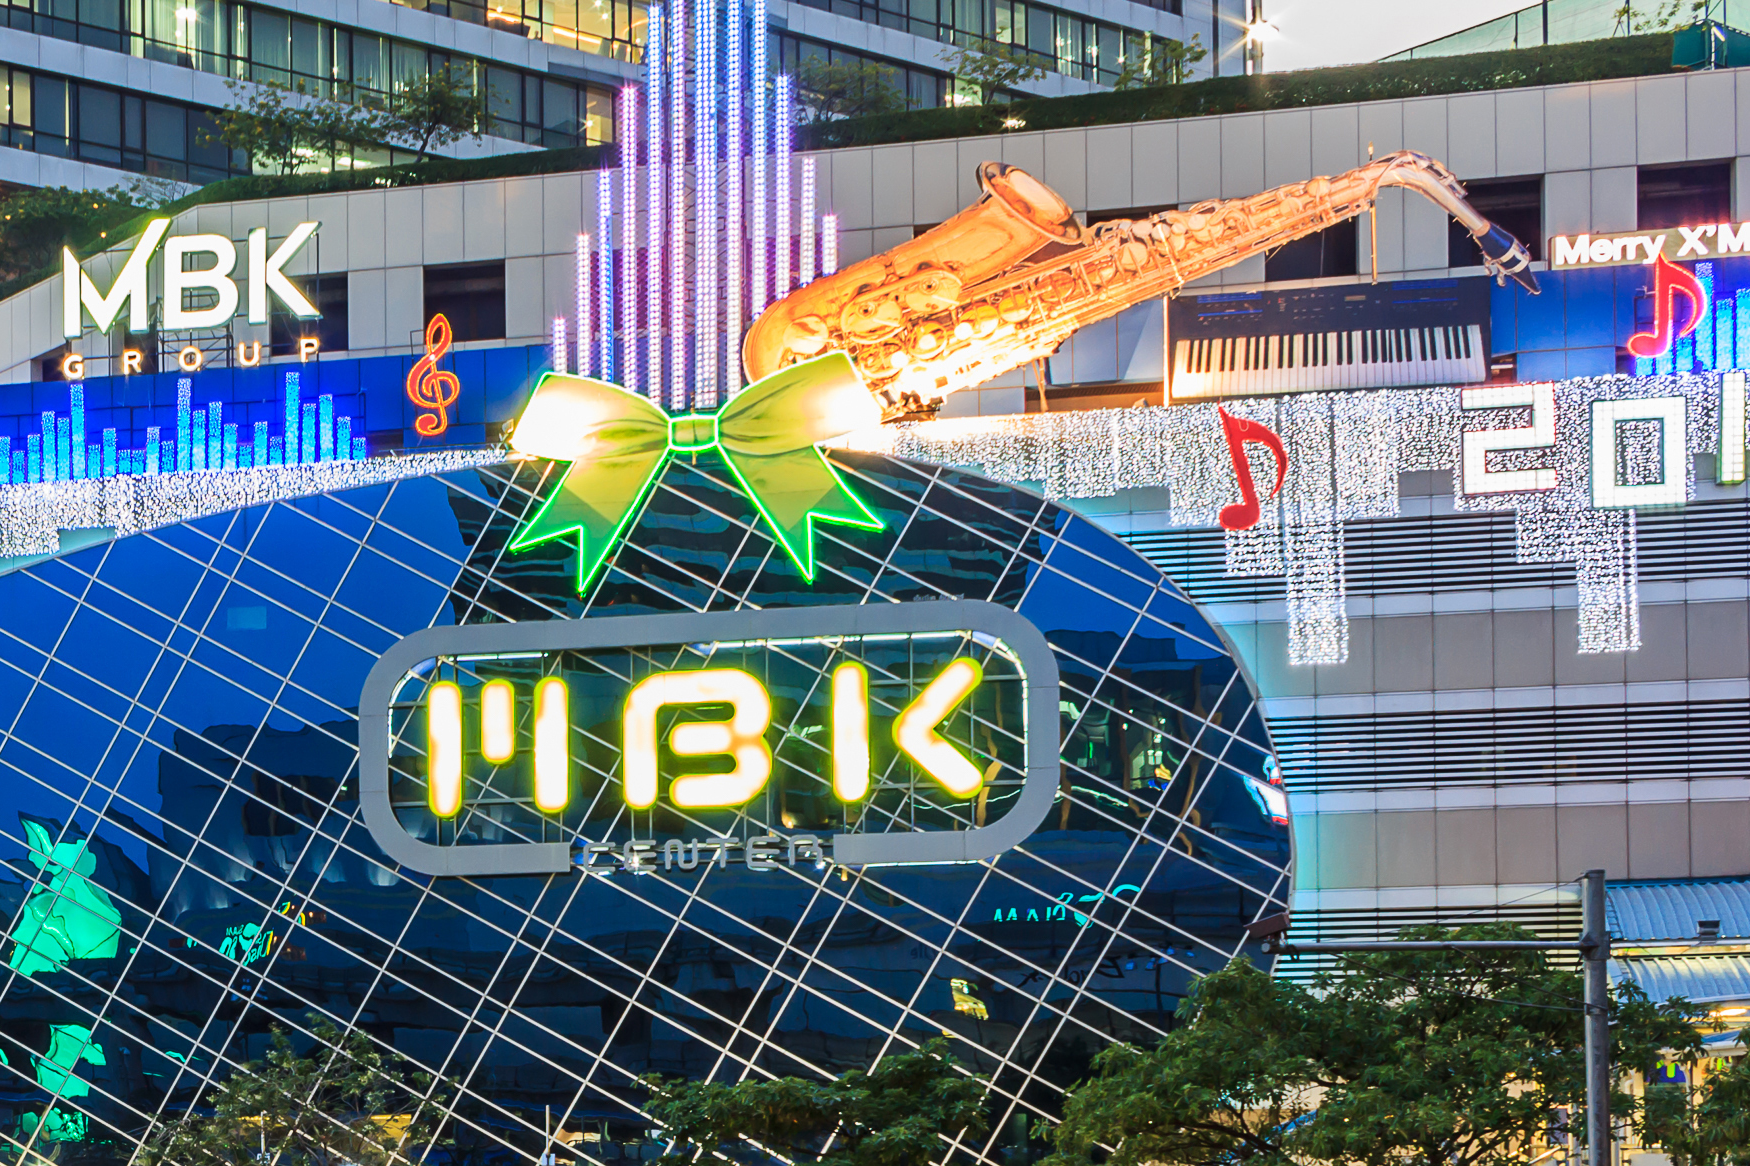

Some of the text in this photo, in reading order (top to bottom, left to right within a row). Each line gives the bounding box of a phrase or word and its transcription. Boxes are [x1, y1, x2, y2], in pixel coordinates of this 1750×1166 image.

[1555, 234, 1666, 265] Merry
[63, 217, 322, 340] MBK
[63, 337, 320, 380] GROUP
[428, 658, 984, 817] MBK
[581, 834, 825, 872] CENTER
